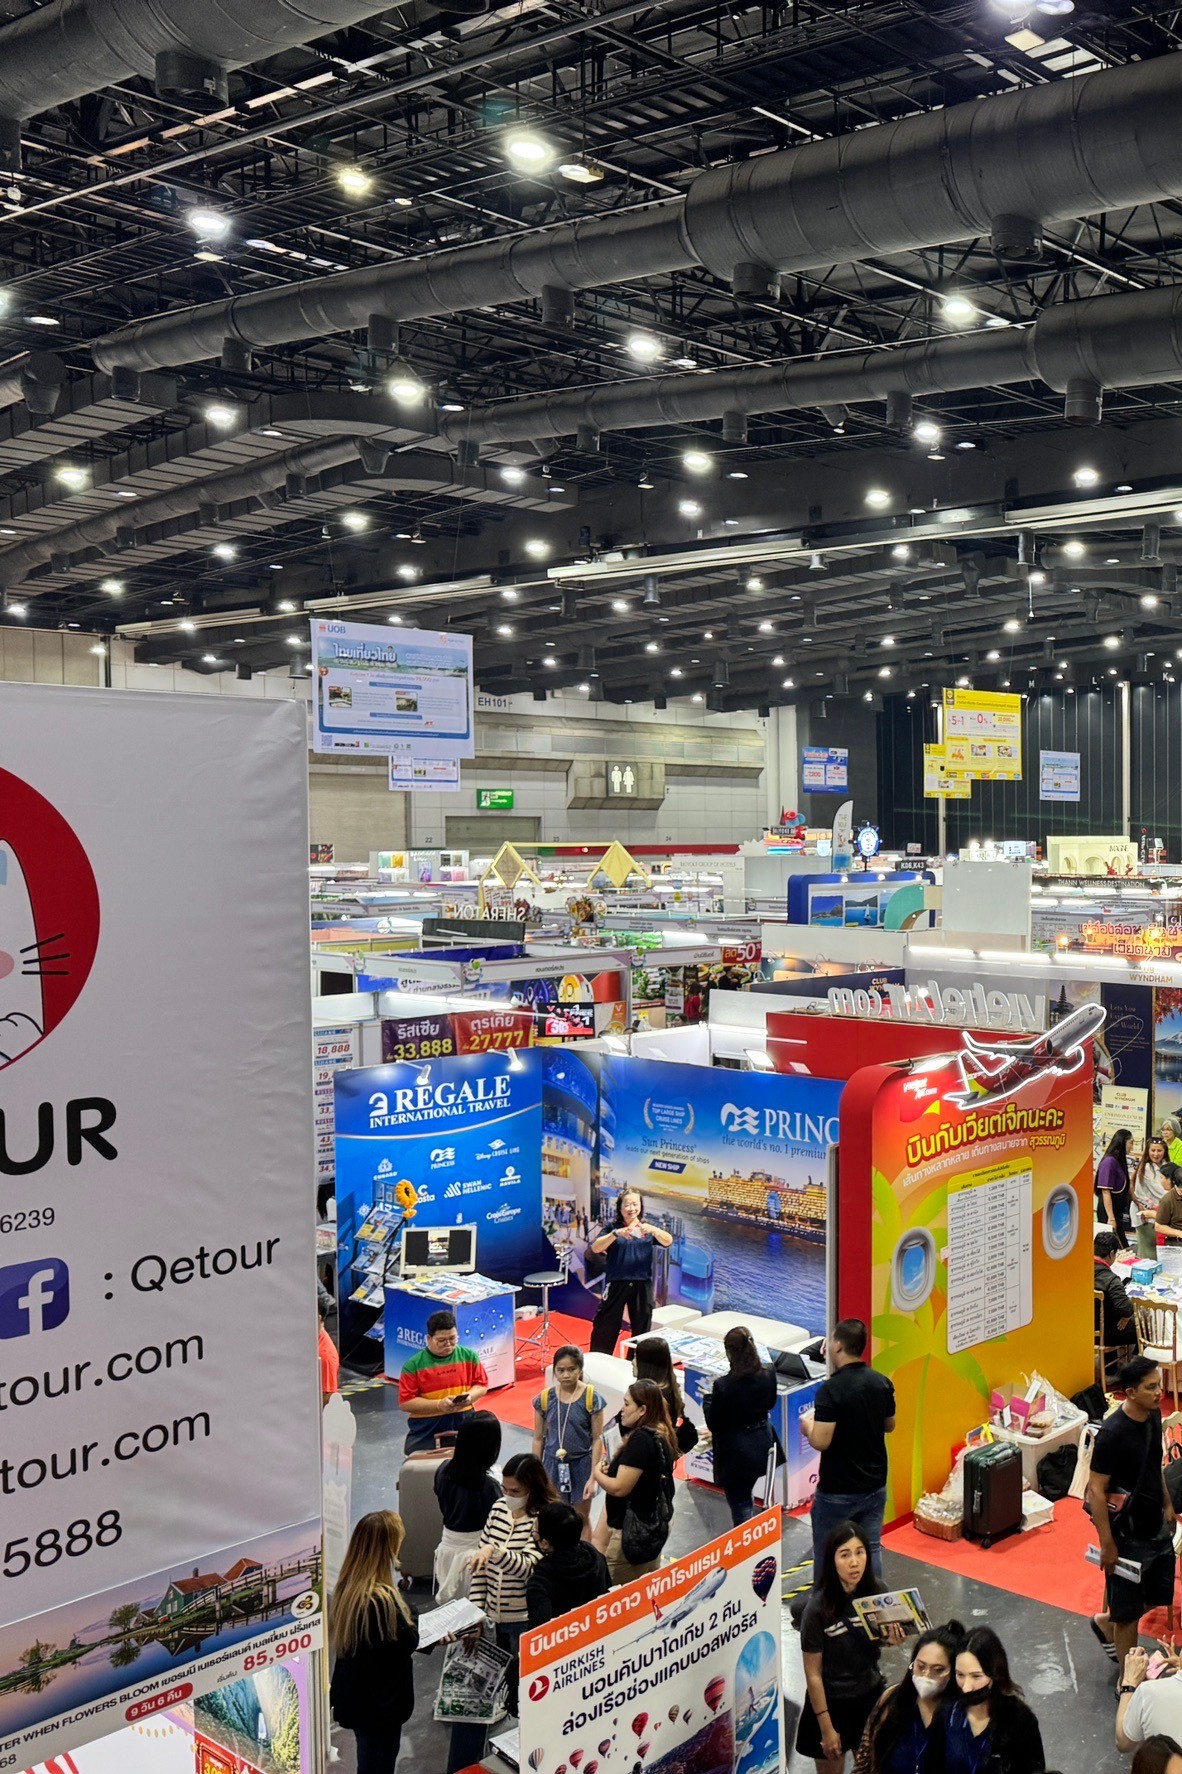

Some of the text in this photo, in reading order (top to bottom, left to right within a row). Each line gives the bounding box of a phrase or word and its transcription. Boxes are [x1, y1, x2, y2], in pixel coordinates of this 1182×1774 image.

[327, 624, 346, 634] UOB
[333, 643, 397, 661] ไทยเที่ยวไทย
[478, 697, 507, 708] EH101
[1079, 879, 1107, 887] WELLNESS
[1130, 974, 1173, 983] WYNDHAM
[398, 1020, 440, 1039] รัสเซีย
[470, 1011, 515, 1031] ตุรเคีย
[318, 1044, 350, 1055] 18,888
[393, 1039, 453, 1060] 33,888
[469, 1031, 524, 1050] 27,777
[394, 1075, 511, 1113] REGALE
[369, 1098, 511, 1129] INTERNATIONAL TRAVEL
[763, 1108, 839, 1144] PRINC
[906, 1102, 1064, 1164] บินกับเวียตเจ็ทนะคะ
[642, 1136, 658, 1147] Sun
[723, 1135, 735, 1145] the
[737, 1137, 768, 1150] world's
[770, 1143, 783, 1154] no.
[431, 1160, 455, 1169] PRINCESS
[649, 1148, 661, 1157] next
[662, 1151, 689, 1162] generation
[696, 1157, 710, 1165] ships
[655, 1161, 680, 1171] NEW SHIP
[902, 1150, 970, 1187] เส้นทางหลากหลาย
[1029, 1133, 1066, 1151] สุวรรณภูมิ
[462, 1184, 492, 1195] HELLENIC
[463, 1180, 482, 1189] SWAN
[131, 1237, 280, 1294] Qetour
[0, 1411, 211, 1495] tour.com
[2, 1509, 123, 1578] 5888
[529, 1517, 777, 1657] บินตรง 5ดาว พักโรงแรม 4-5ดาว
[216, 1632, 312, 1684] เริ่มต้น 85,900
[581, 1598, 742, 1701] นอนคัปปาโดเกีย 2 คืน
[553, 1645, 605, 1679] TURKISH
[552, 1658, 605, 1693] AIRLINES
[561, 1611, 758, 1737] ล่องเรือช่องแคบบอสฟอรัส
[23, 1722, 60, 1743] WHEN
[62, 1697, 118, 1732] FLOWERS
[119, 1680, 160, 1704] BLOOM
[161, 1662, 197, 1688] เยอรมนี
[197, 1642, 252, 1673] เนเธอร์แลนด์
[131, 1685, 183, 1718] 9 วัน 6 คืน
